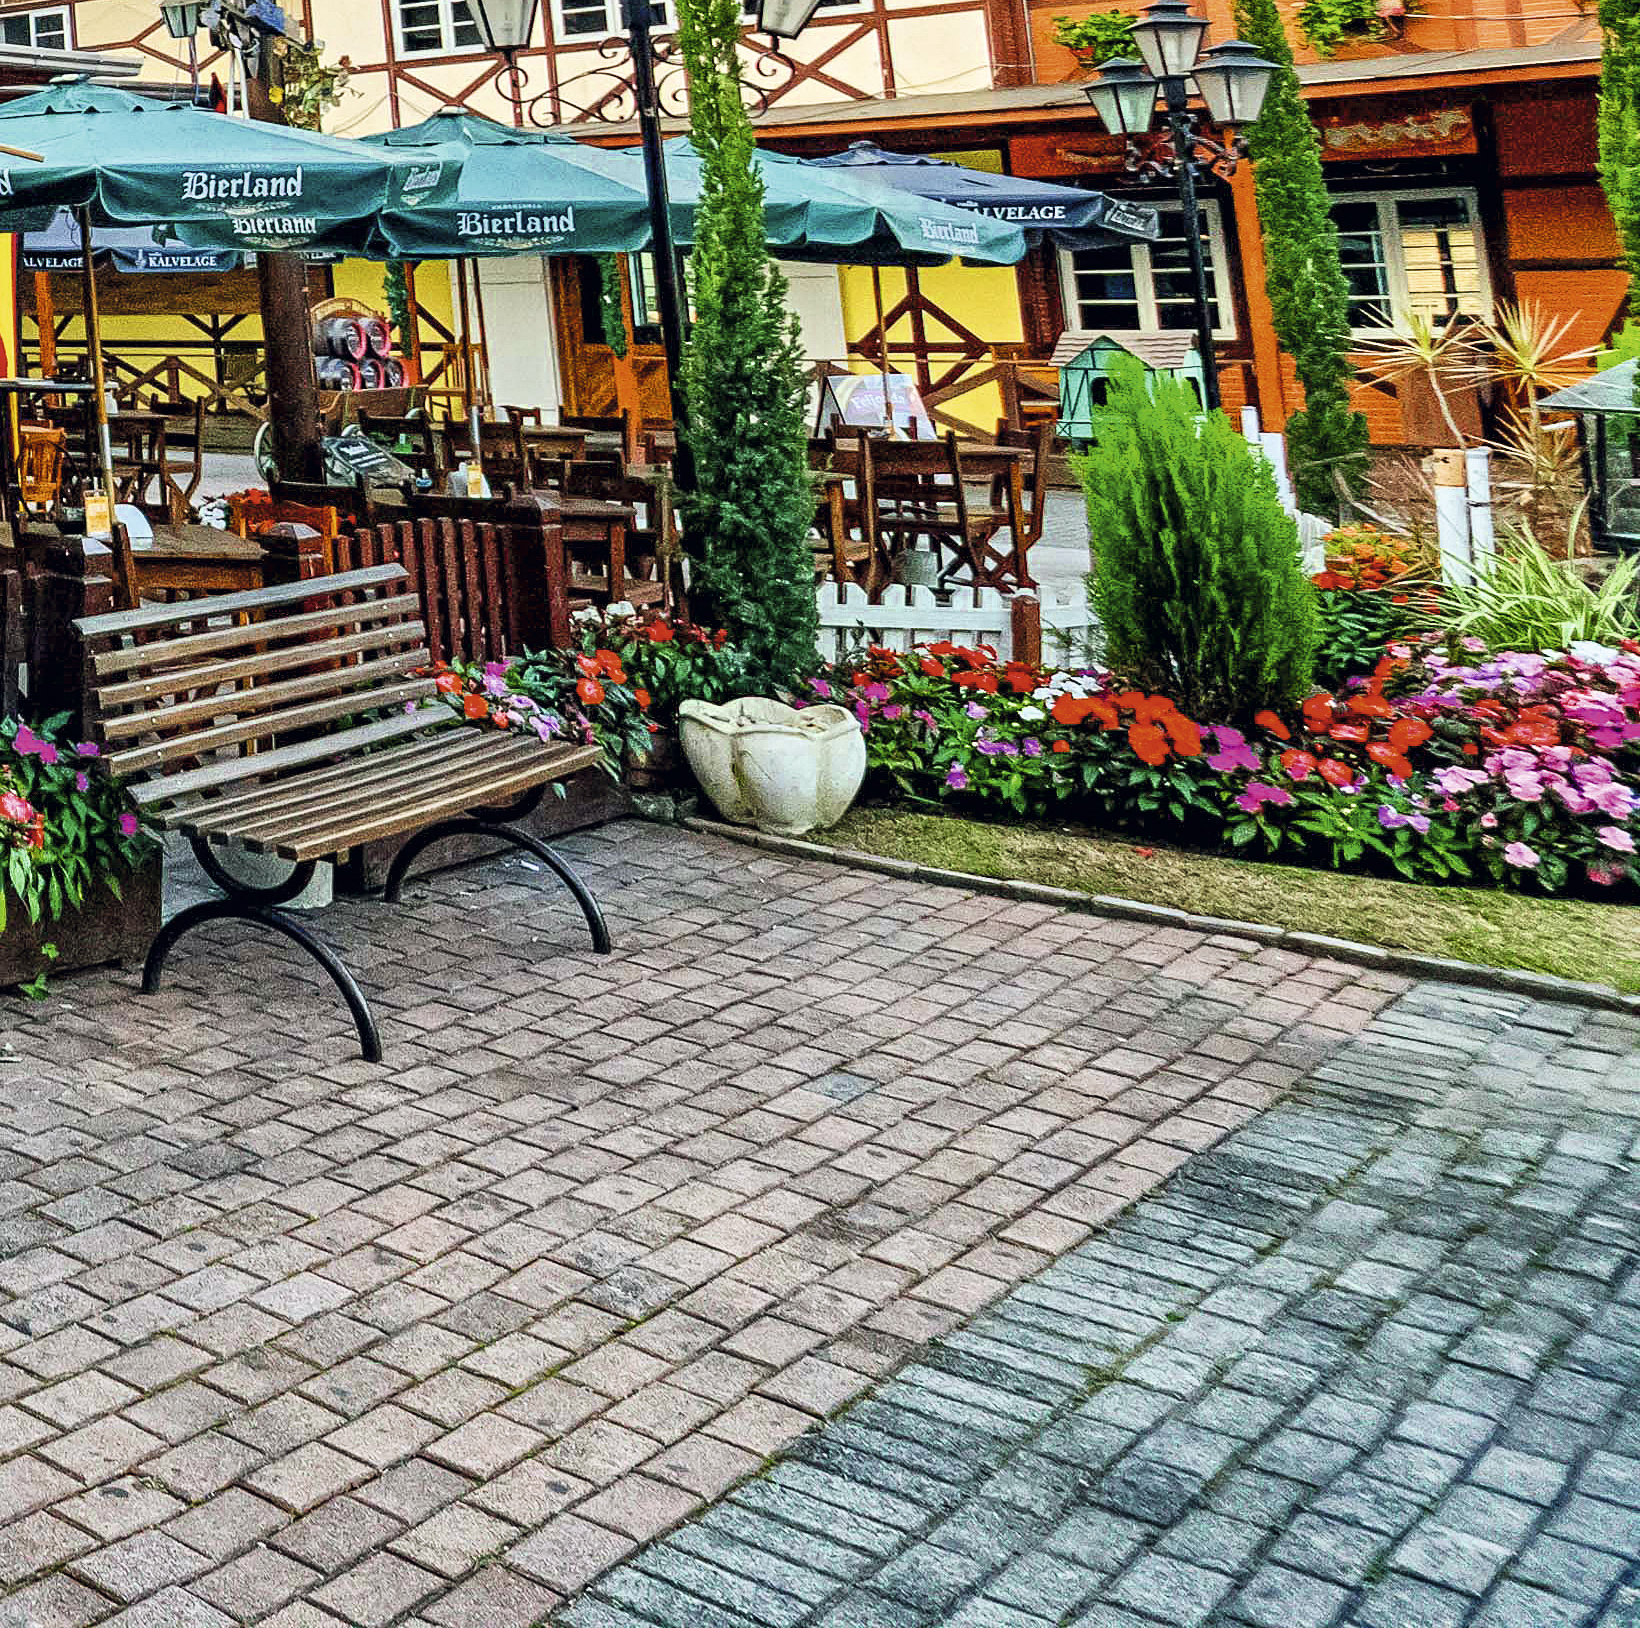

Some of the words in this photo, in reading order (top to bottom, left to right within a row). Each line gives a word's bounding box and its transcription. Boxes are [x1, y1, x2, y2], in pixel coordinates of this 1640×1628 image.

[183, 164, 304, 200] Bierland
[456, 205, 576, 236] Bierland
[148, 255, 217, 268] KALVELAGE
